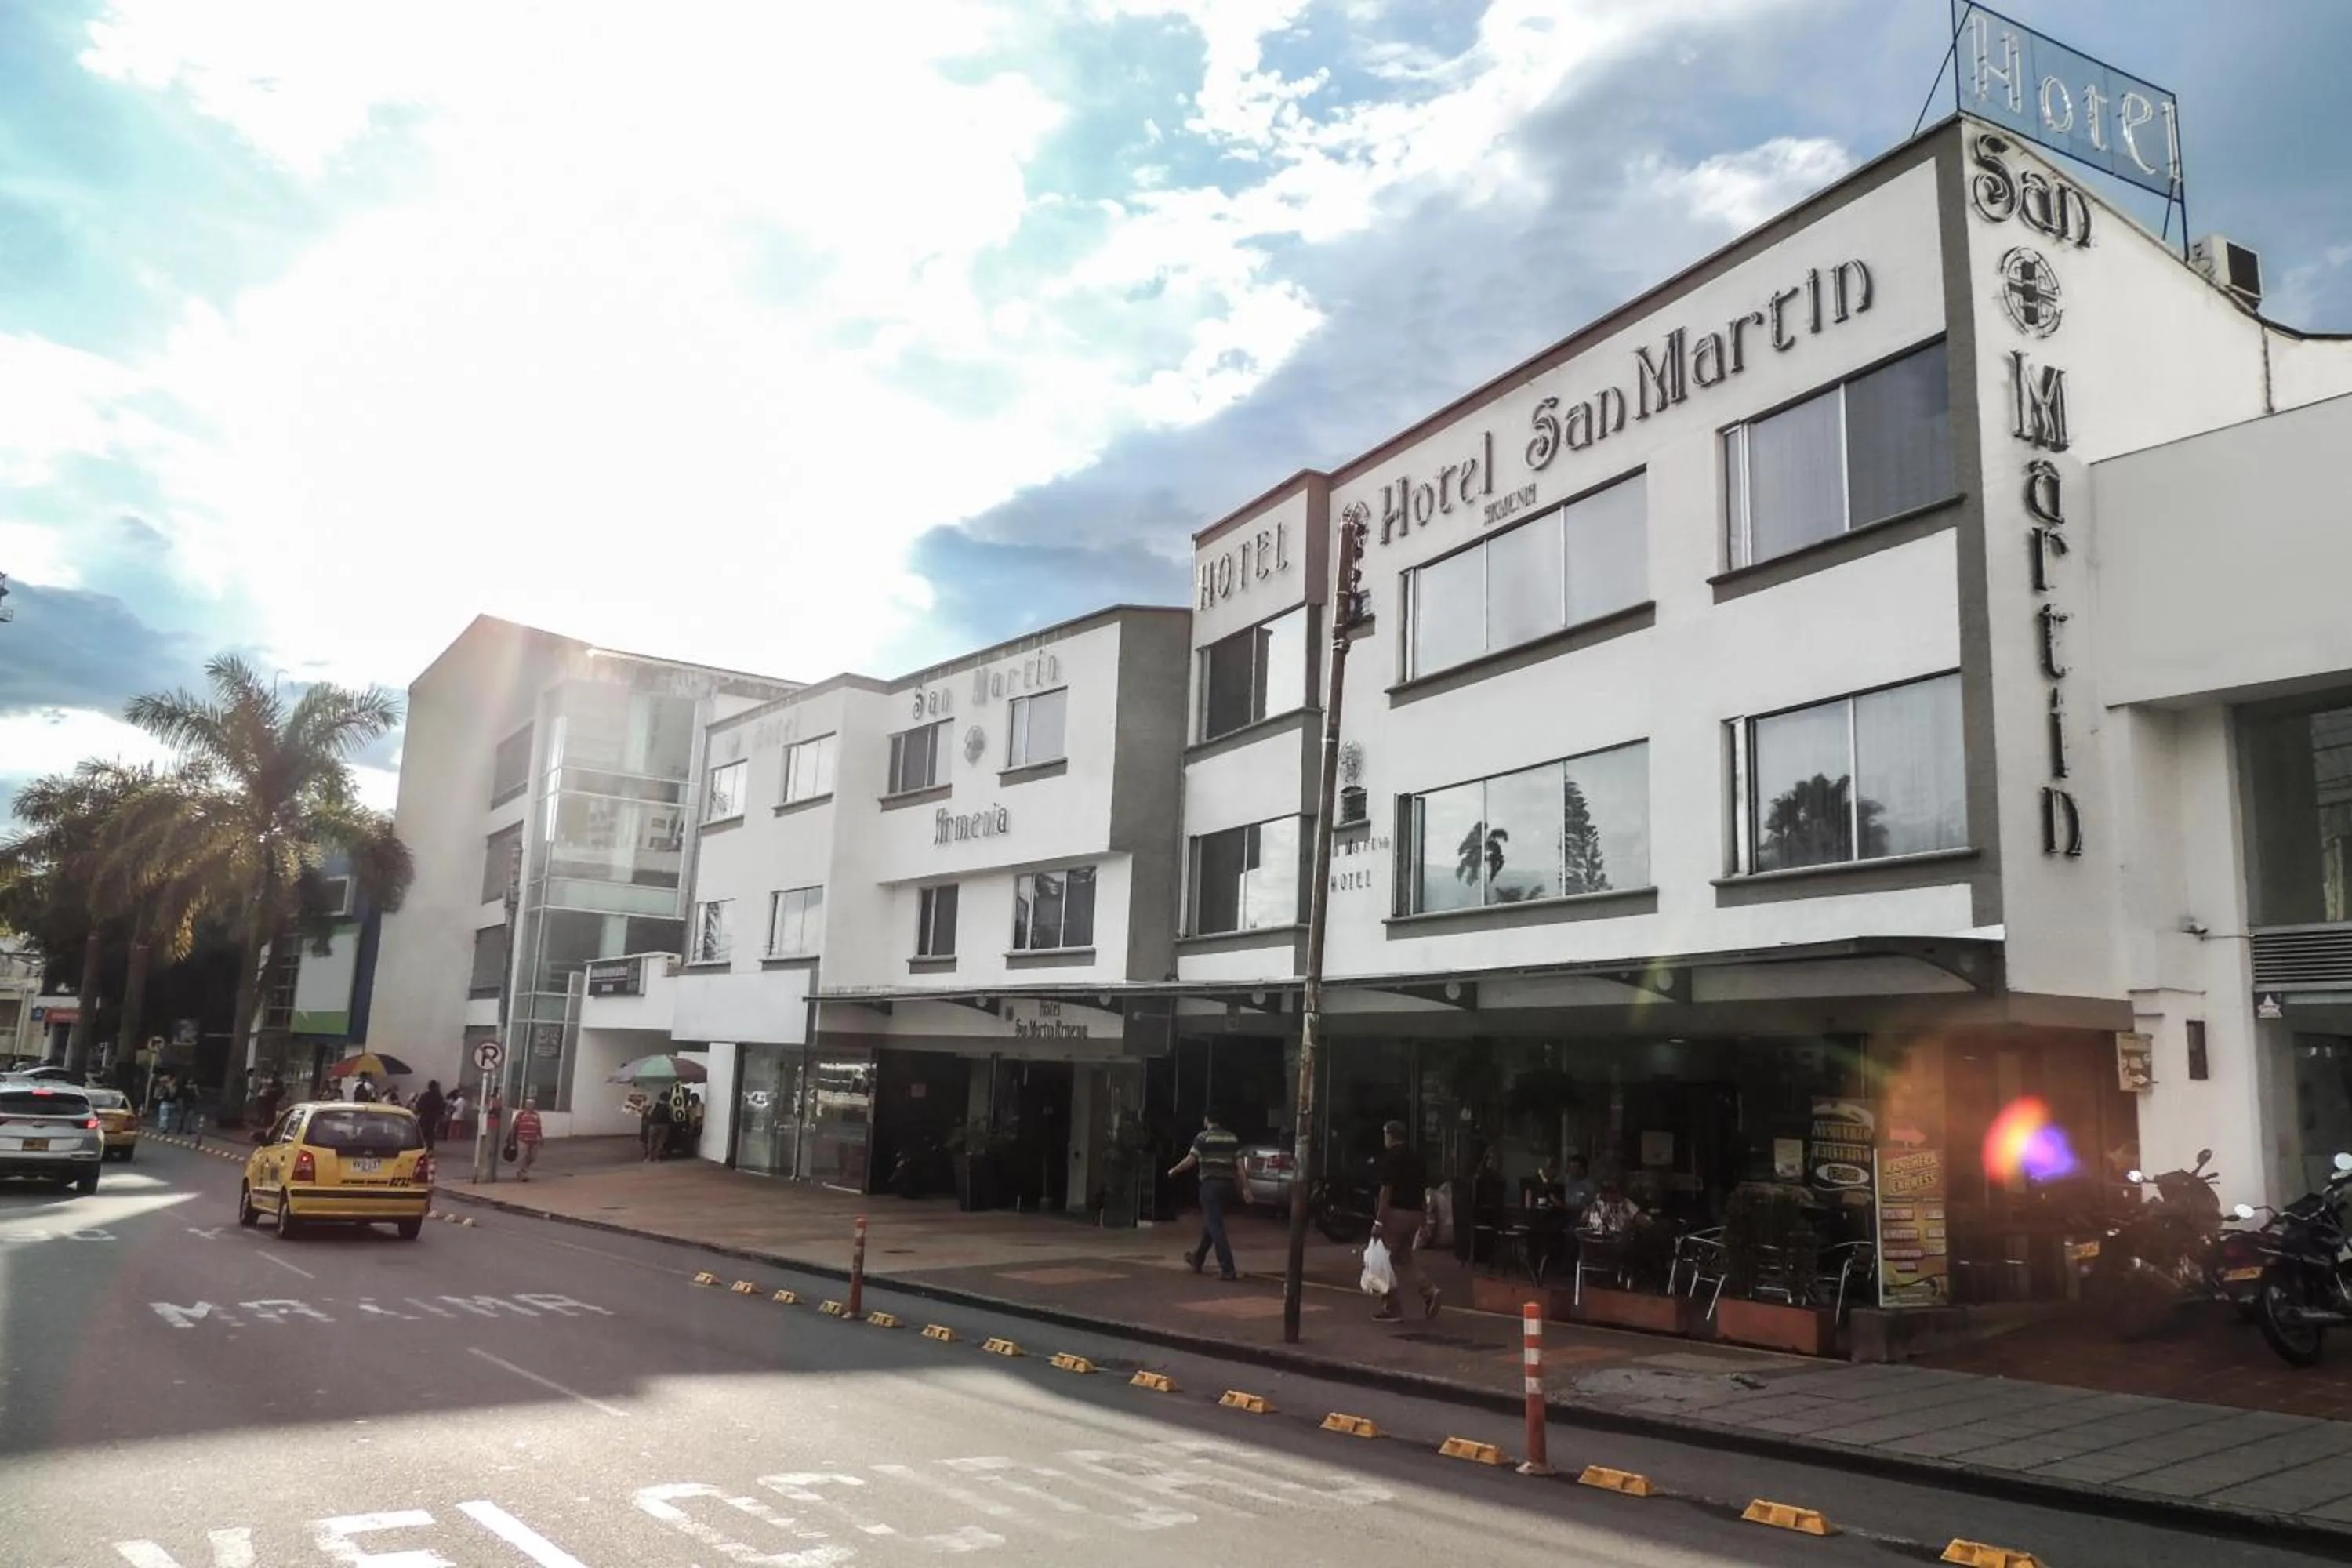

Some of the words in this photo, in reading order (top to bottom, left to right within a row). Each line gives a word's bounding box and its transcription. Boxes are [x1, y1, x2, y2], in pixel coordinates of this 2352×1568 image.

[1967, 12, 2183, 184] Hotel
[1970, 132, 2095, 249] San
[1379, 431, 1494, 545] Hotel
[1197, 522, 1290, 611] HOTEL
[912, 684, 953, 720] San
